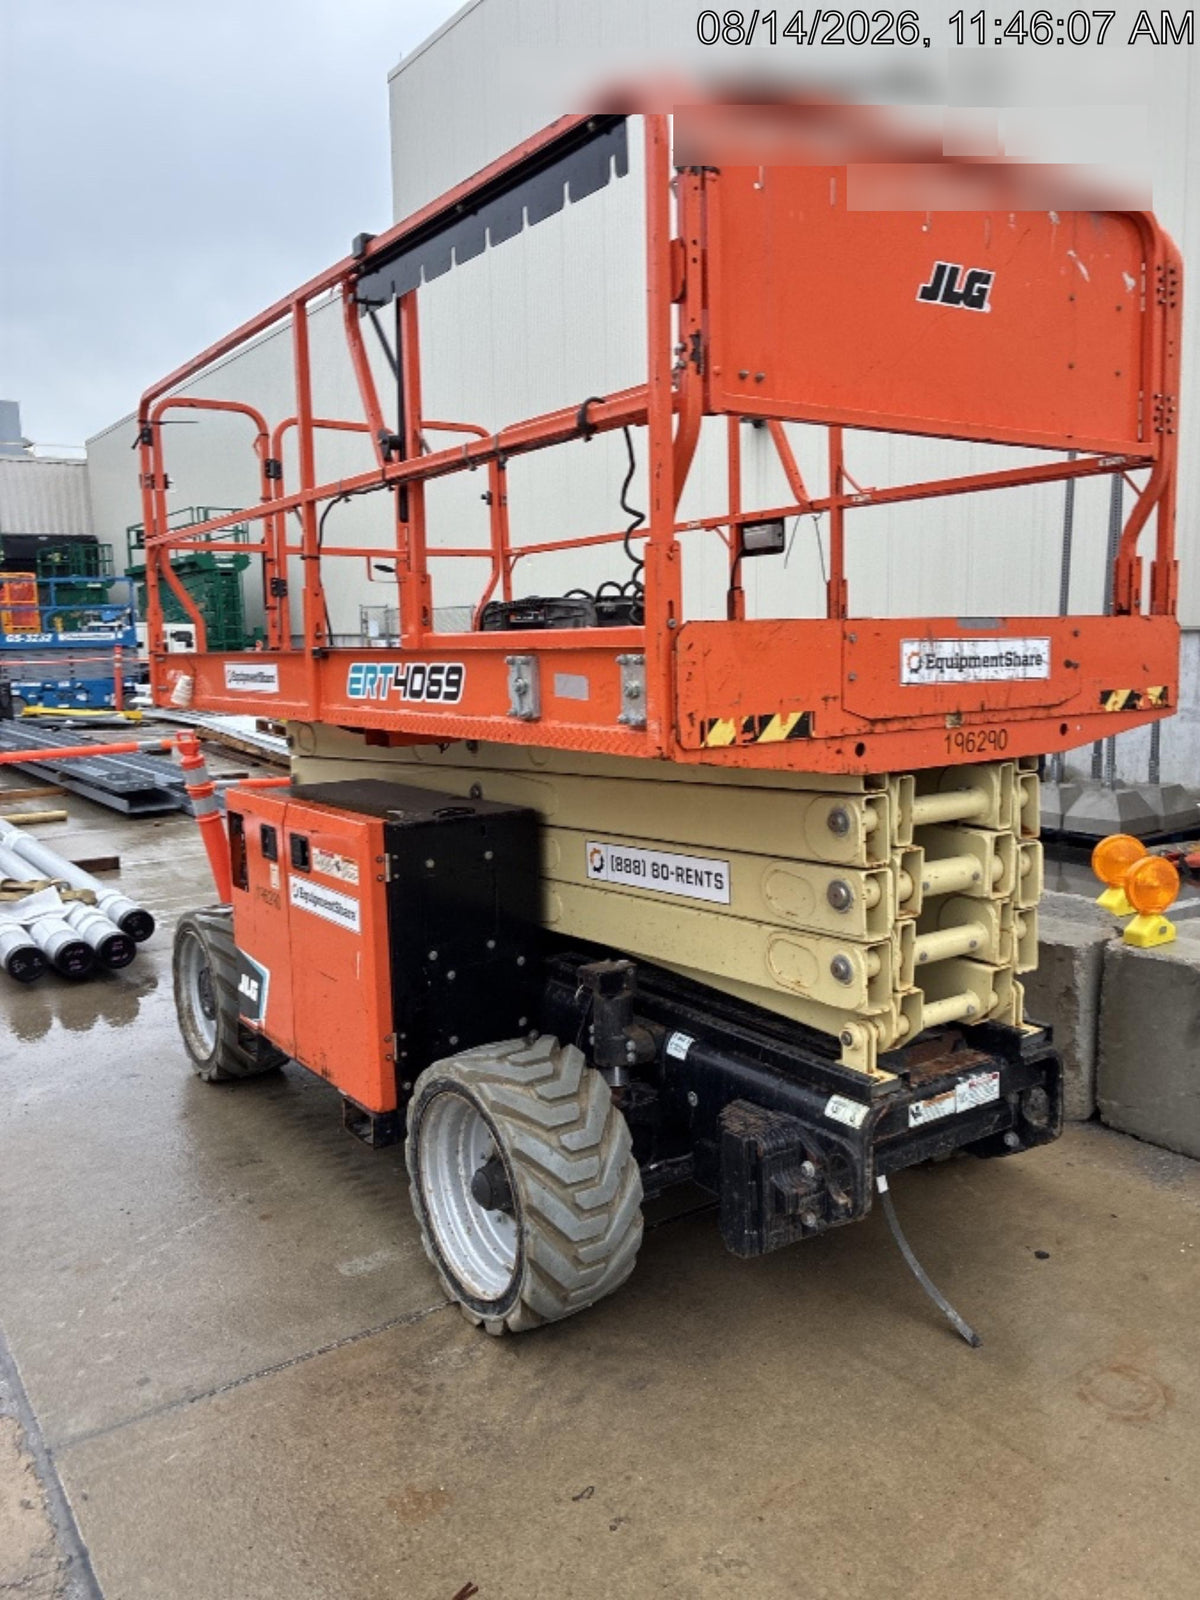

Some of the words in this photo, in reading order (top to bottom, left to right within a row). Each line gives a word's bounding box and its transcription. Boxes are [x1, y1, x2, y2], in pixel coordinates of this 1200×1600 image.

[917, 262, 994, 311] JLG
[924, 651, 1044, 673] EquipmentShare
[347, 663, 464, 702] ERT4069
[944, 728, 1009, 754] 196290
[651, 861, 725, 890] 80-RENTS
[238, 973, 259, 1002] JLG
